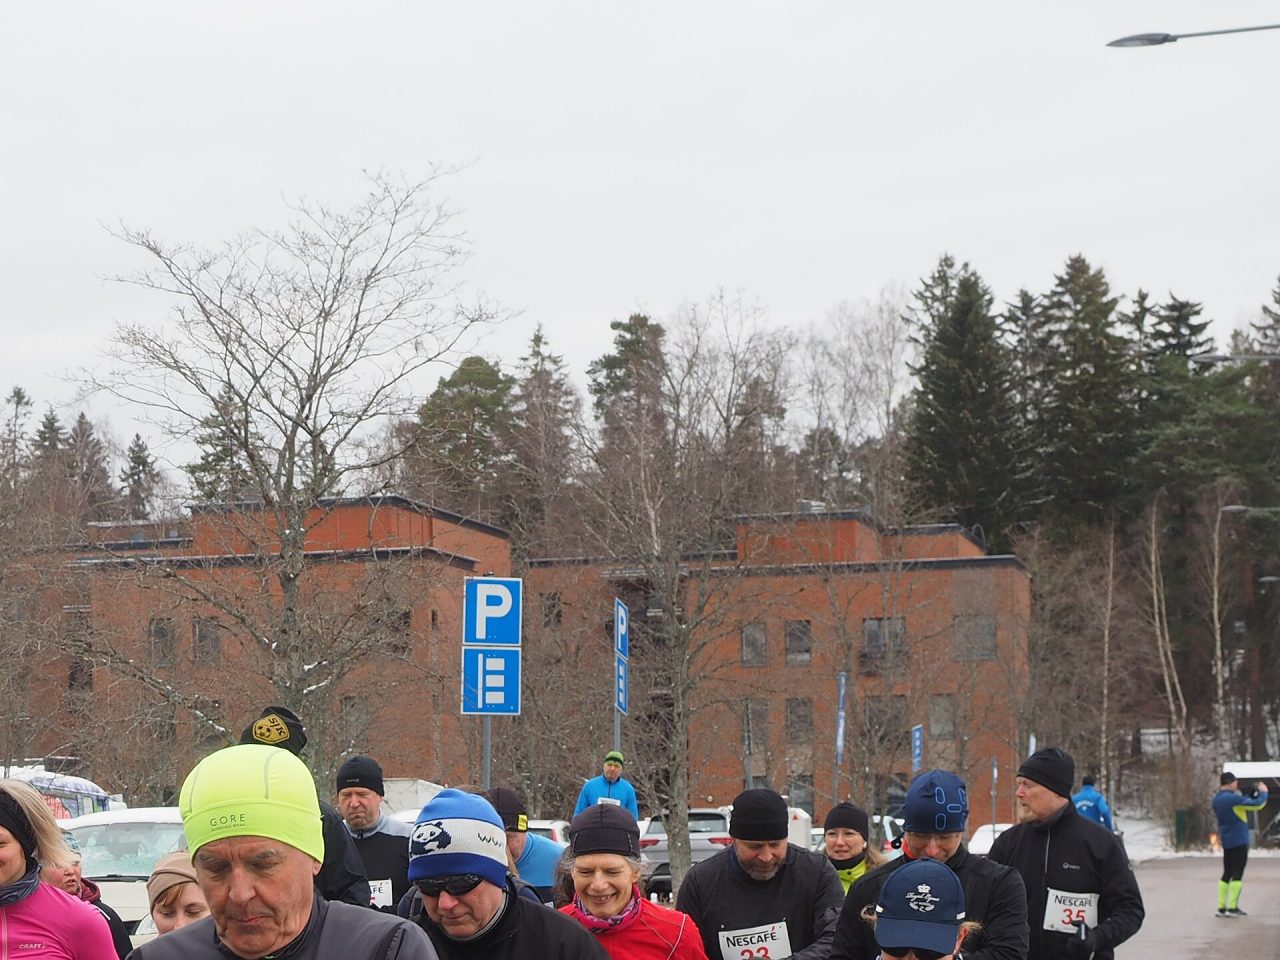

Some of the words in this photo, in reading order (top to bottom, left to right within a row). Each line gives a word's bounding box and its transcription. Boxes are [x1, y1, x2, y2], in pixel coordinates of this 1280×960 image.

[476, 583, 513, 639] P
[209, 814, 246, 827] GORE
[726, 926, 778, 947] NESCAFÉ
